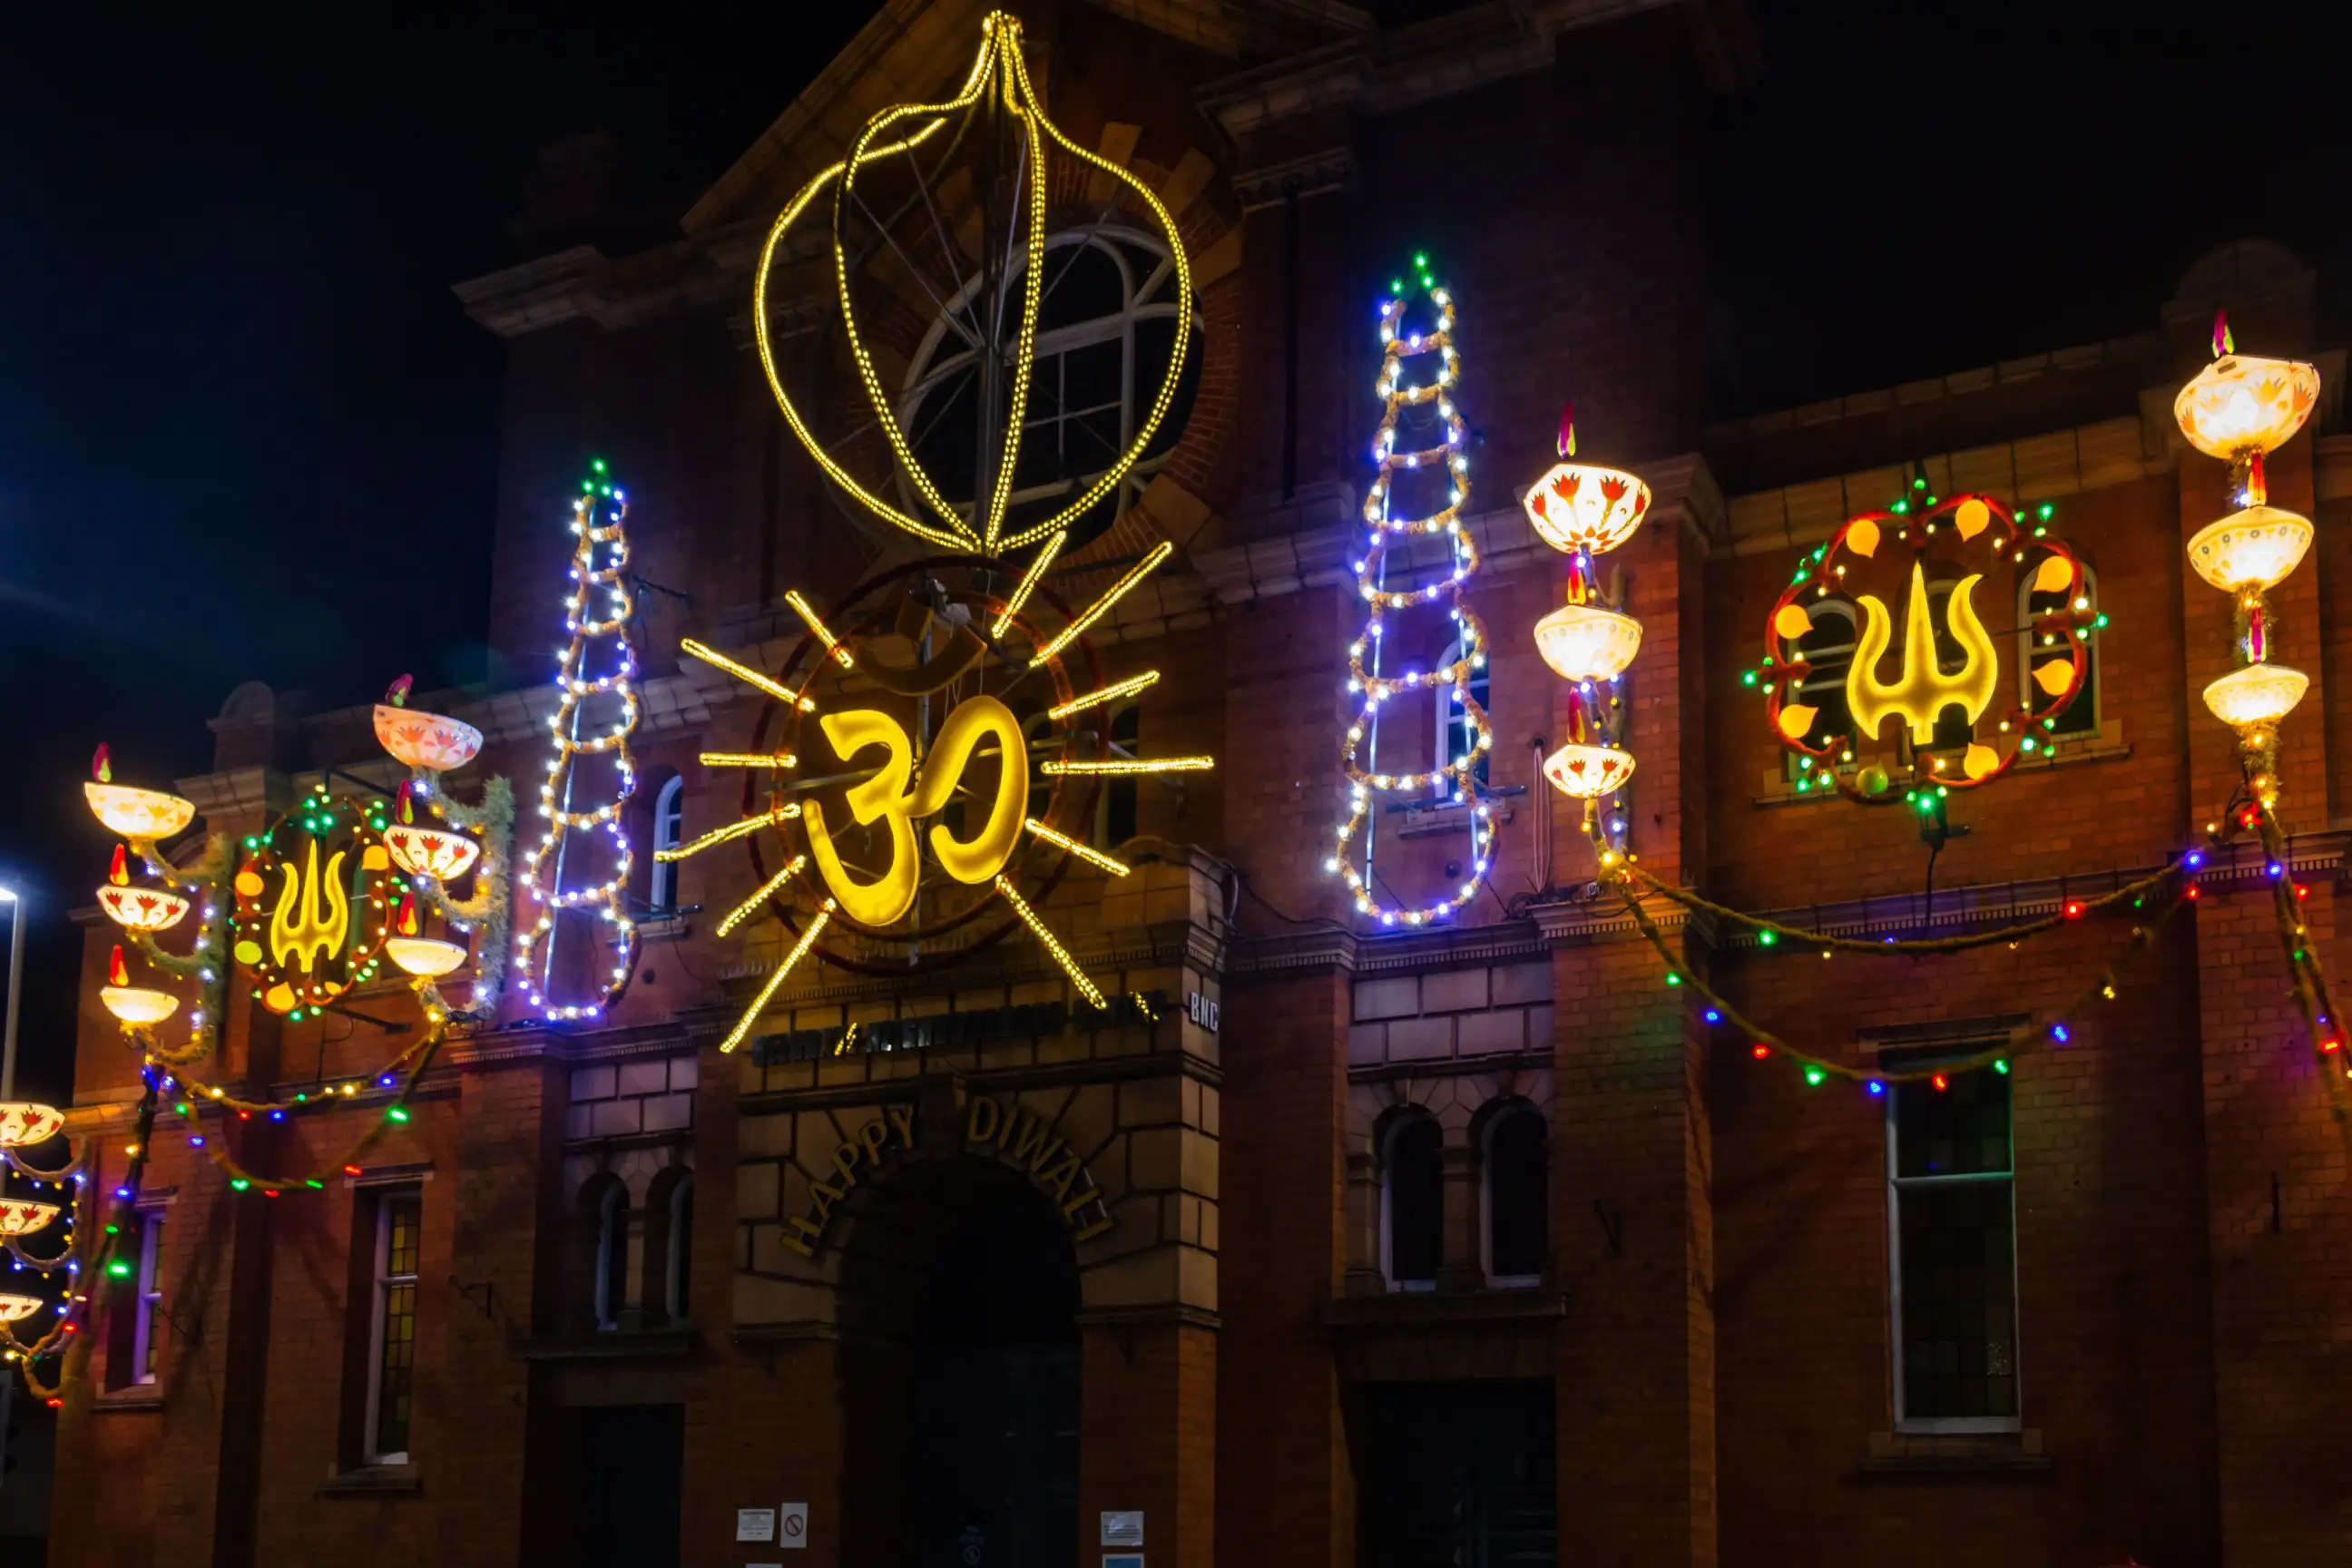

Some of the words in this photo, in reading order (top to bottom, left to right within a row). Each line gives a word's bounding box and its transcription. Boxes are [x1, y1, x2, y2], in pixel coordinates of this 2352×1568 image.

[1190, 991, 1220, 1033] BNC
[779, 1100, 916, 1259] HAPPY
[966, 1094, 1115, 1243] DIWALI
